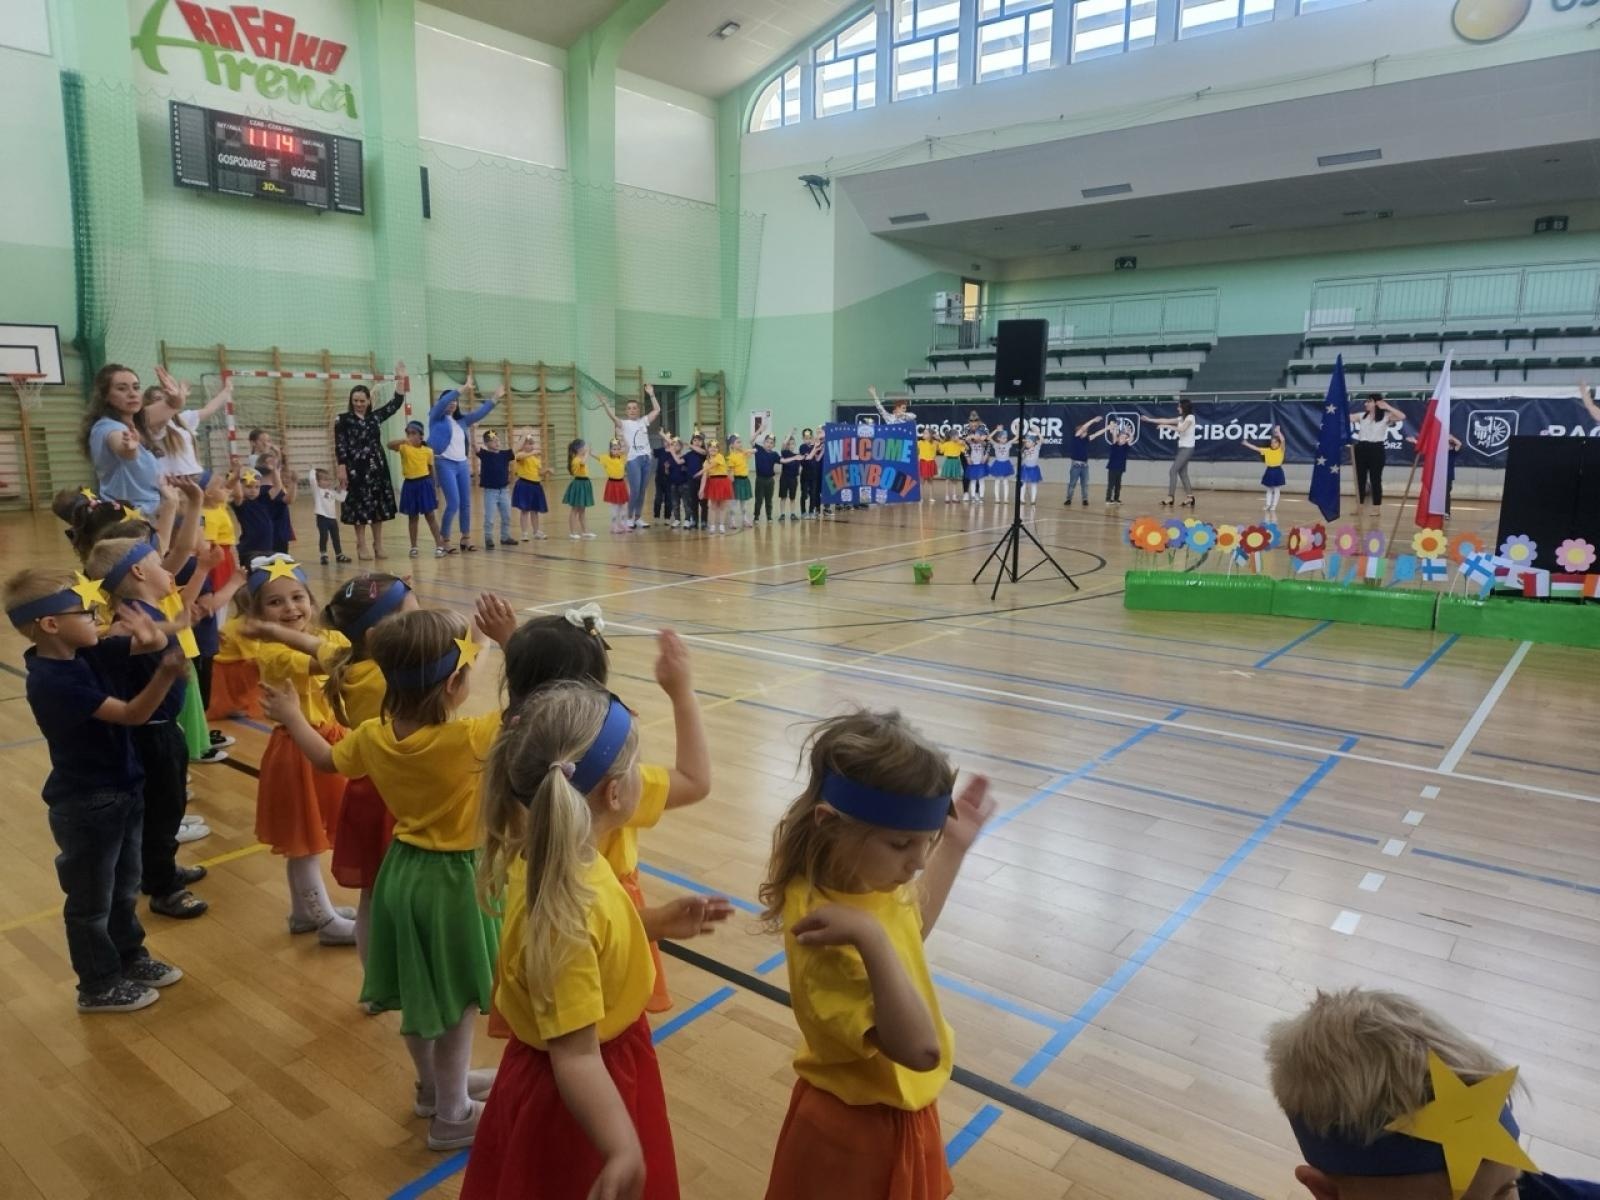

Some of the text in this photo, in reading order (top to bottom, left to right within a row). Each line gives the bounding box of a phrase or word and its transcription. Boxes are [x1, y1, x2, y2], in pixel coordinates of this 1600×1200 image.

[175, 0, 347, 75] RAFAKO
[130, 0, 358, 119] Arena
[218, 153, 267, 171] GOSPODARZE
[290, 165, 318, 181] GOŚCIE
[828, 437, 913, 465] WELCOME
[825, 463, 917, 497] EVERYBODY
